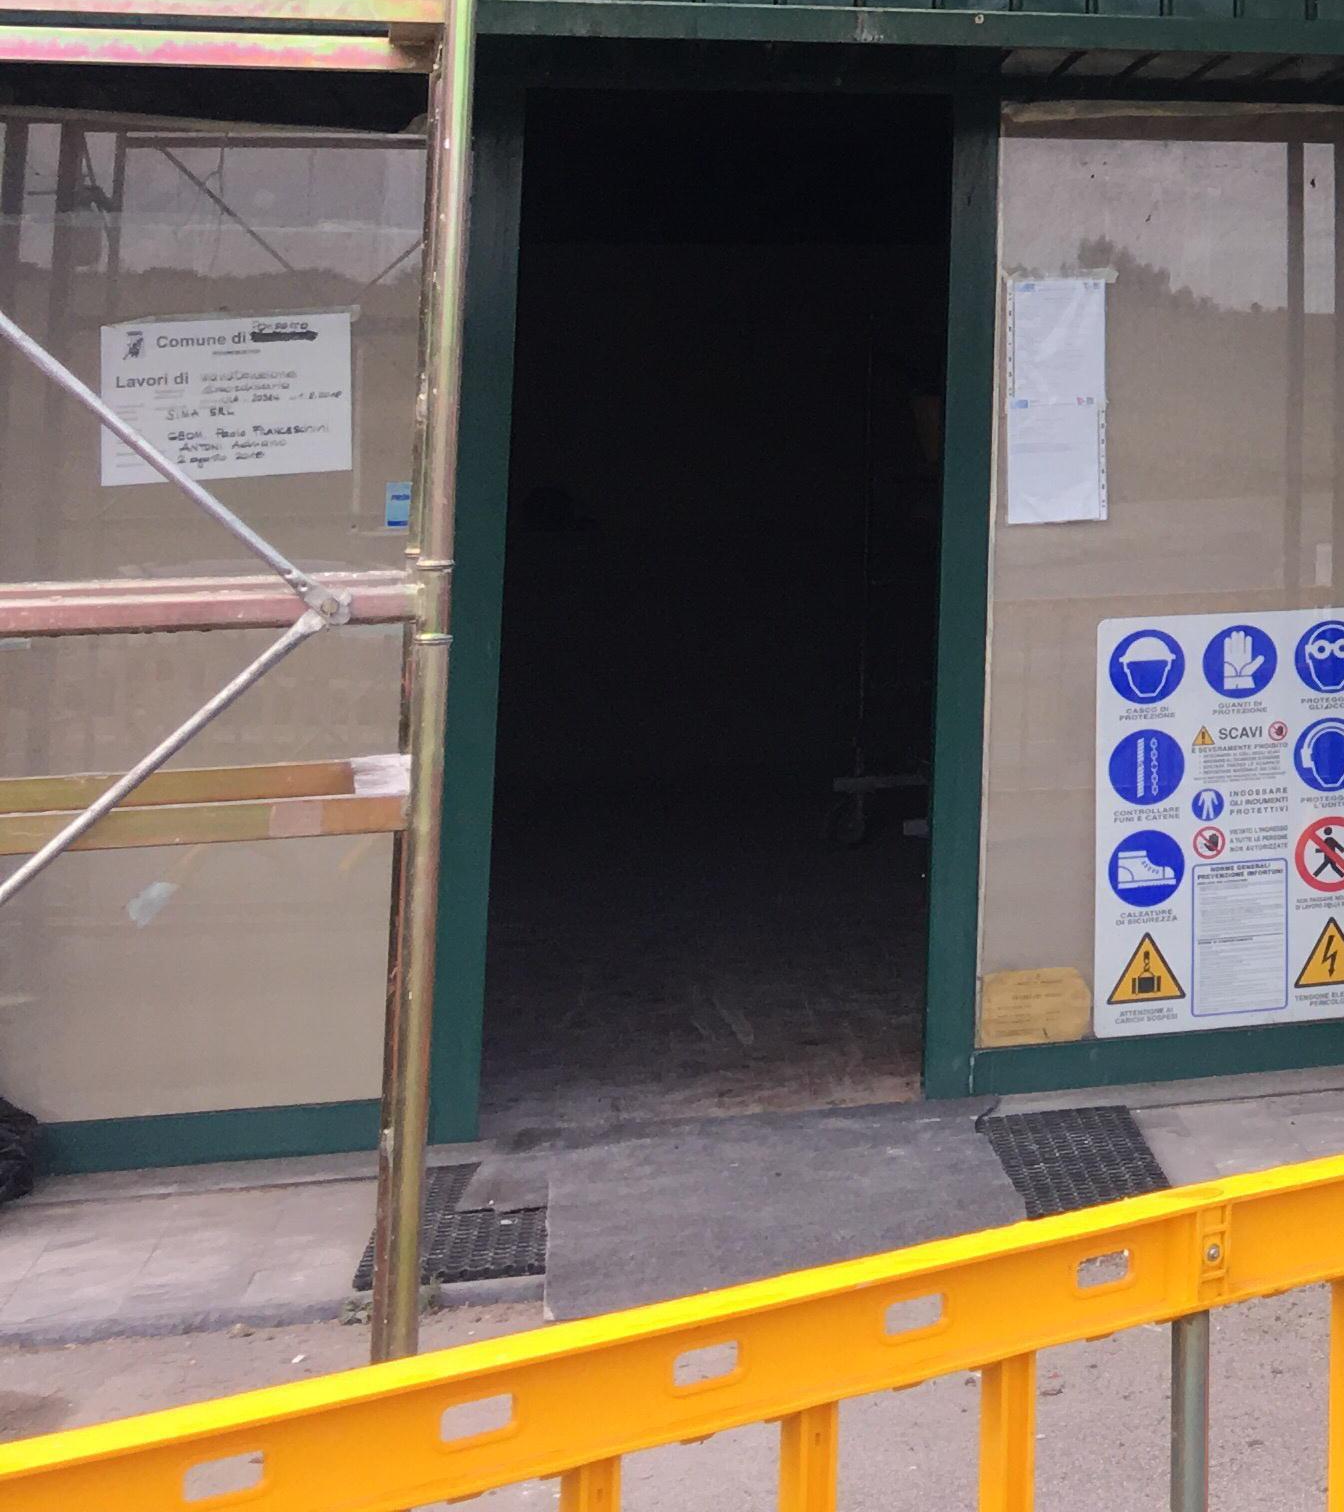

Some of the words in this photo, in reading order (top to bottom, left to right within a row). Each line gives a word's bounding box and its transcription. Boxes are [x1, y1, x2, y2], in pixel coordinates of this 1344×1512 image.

[156, 335, 227, 349] Comune
[231, 332, 246, 345] di
[115, 372, 169, 389] Lavori
[176, 372, 189, 386] di
[1218, 726, 1263, 740] SCAVI
[1113, 806, 1180, 817] CONTROLLARE
[1145, 813, 1180, 821] CATENE
[1120, 909, 1173, 919] CALZATURE
[1127, 915, 1178, 925] SICUREZZA
